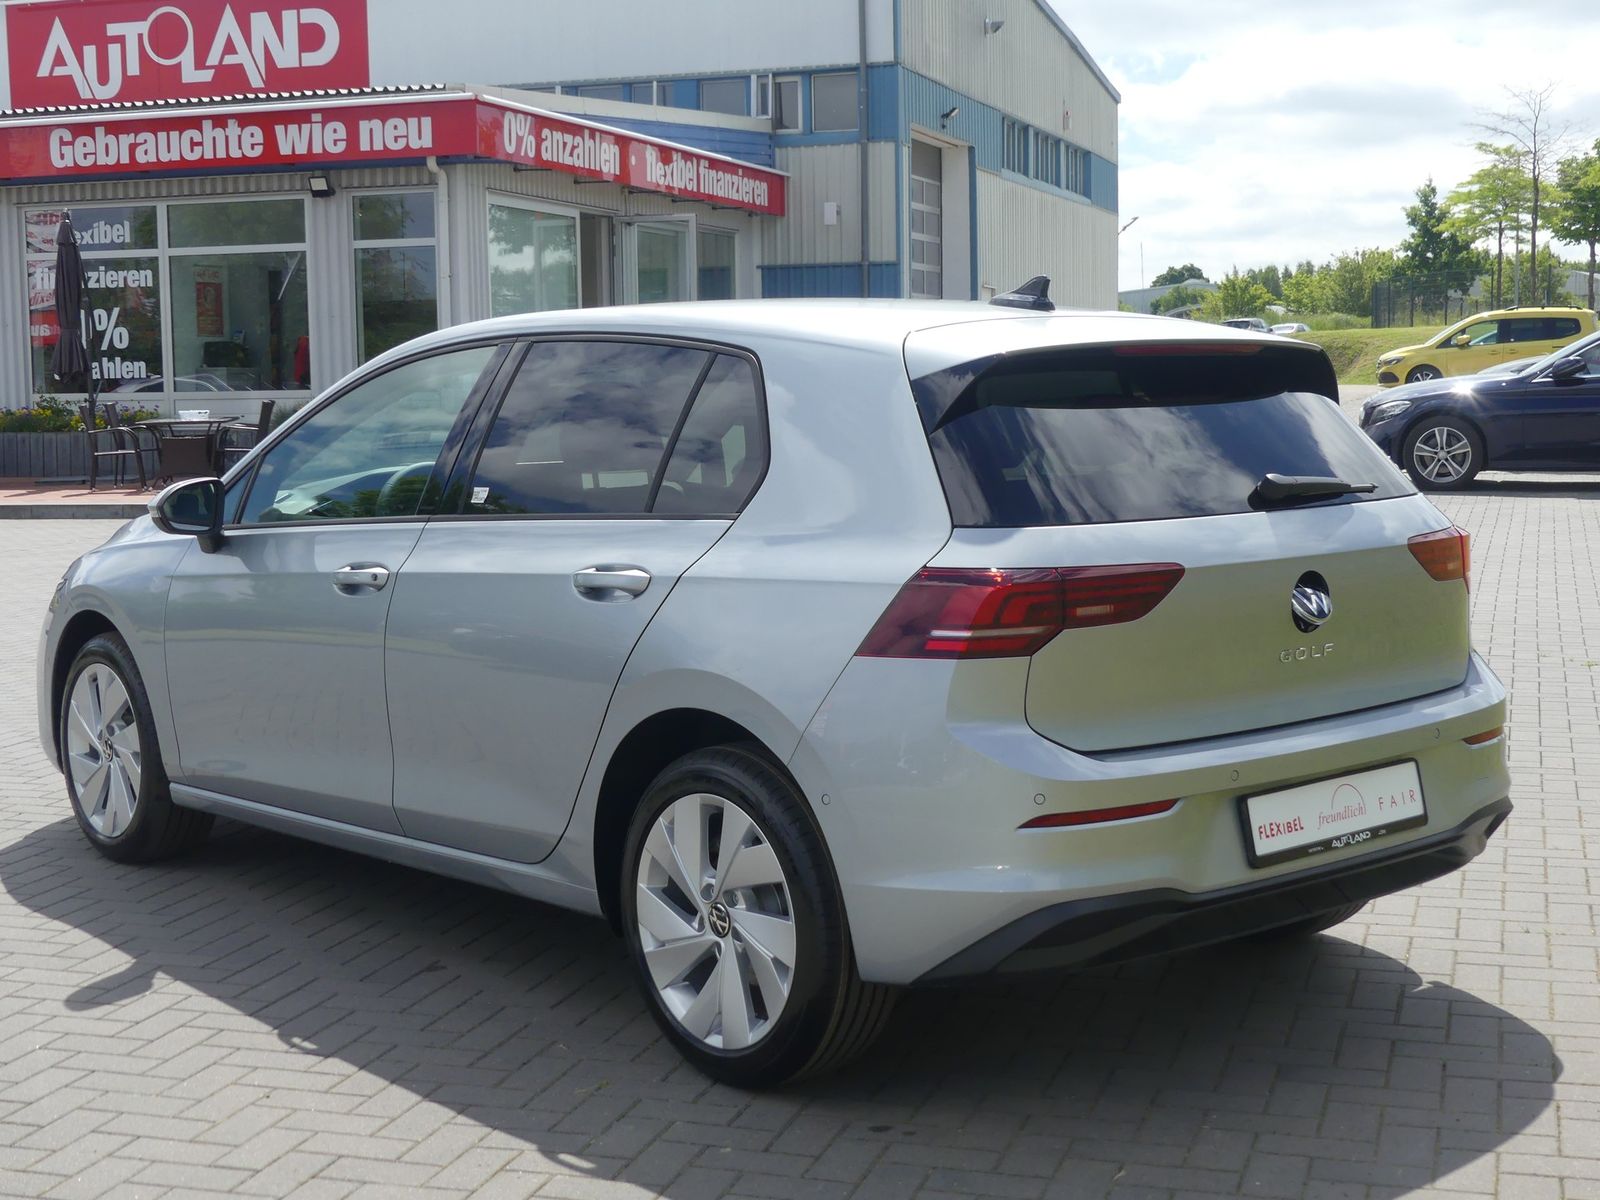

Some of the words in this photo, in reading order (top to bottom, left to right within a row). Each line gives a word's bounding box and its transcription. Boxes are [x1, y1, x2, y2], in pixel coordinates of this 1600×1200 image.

[36, 3, 341, 100] AUTOLAND
[49, 118, 264, 168] Gebrauchte
[275, 112, 347, 156] wie
[359, 115, 433, 152] neu
[504, 110, 536, 158] 0%
[541, 127, 621, 176] anzahlen
[645, 143, 698, 192] flexibel
[699, 159, 769, 207] finanzieren
[72, 219, 131, 245] exibel
[1279, 642, 1335, 663] GOLF
[1258, 815, 1305, 840] FLEXIBEL
[1317, 802, 1367, 830] freundlich
[1378, 789, 1417, 811] FAIR
